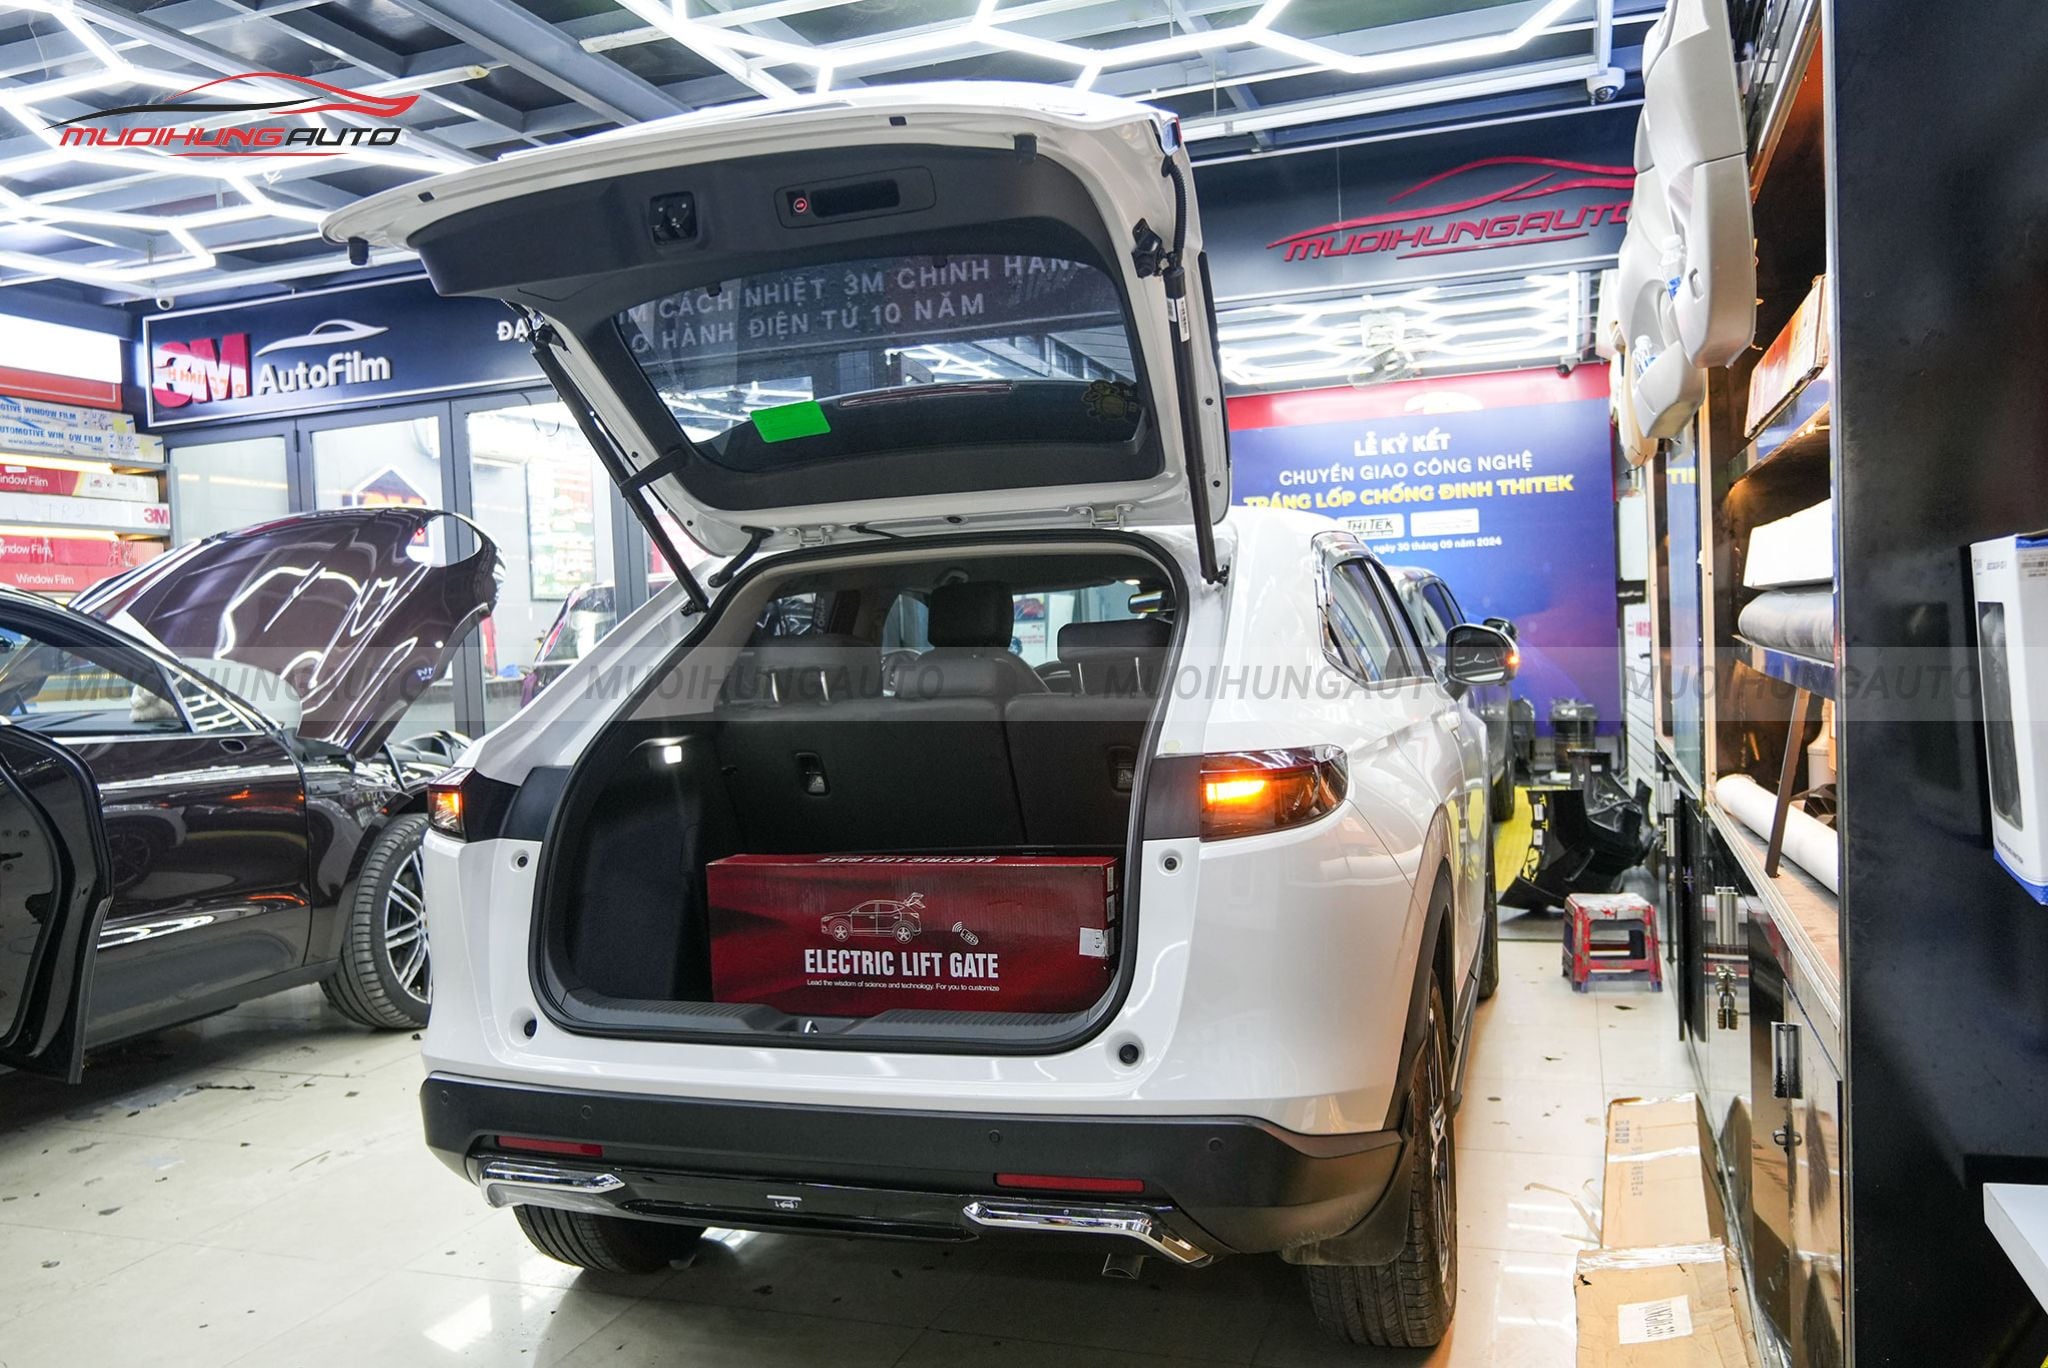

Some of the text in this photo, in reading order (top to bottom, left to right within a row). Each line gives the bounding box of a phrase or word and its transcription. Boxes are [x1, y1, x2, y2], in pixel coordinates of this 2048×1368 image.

[745, 276, 826, 307] NHIỆT
[843, 271, 885, 295] 3M
[662, 321, 735, 349] HÀNH
[748, 311, 809, 340] ĐIỆN
[871, 303, 899, 325] 10
[914, 292, 985, 320] NĂM
[152, 332, 250, 409] 3M
[257, 350, 391, 396] AutoFilm
[59, 411, 77, 420] FILM
[84, 435, 103, 443] FILM
[1359, 462, 1409, 480] GIAO
[1413, 457, 1473, 477] CÔNG
[1477, 449, 1533, 472] NGHỆ
[29, 475, 49, 487] Film
[1359, 482, 1435, 506] CHỐNG
[1438, 480, 1494, 500] ĐINH
[1496, 474, 1575, 496] THITEK
[143, 508, 169, 524] 3M
[1476, 536, 1503, 547] 2024
[16, 573, 75, 585] Window Film
[804, 949, 999, 979] ELECTRIC LIFT GATE
[807, 979, 823, 987] Lead
[823, 979, 833, 987] the
[834, 980, 856, 988] wisdom
[857, 980, 864, 988] of
[865, 981, 887, 989] science
[888, 981, 900, 989] and
[947, 984, 960, 992] you
